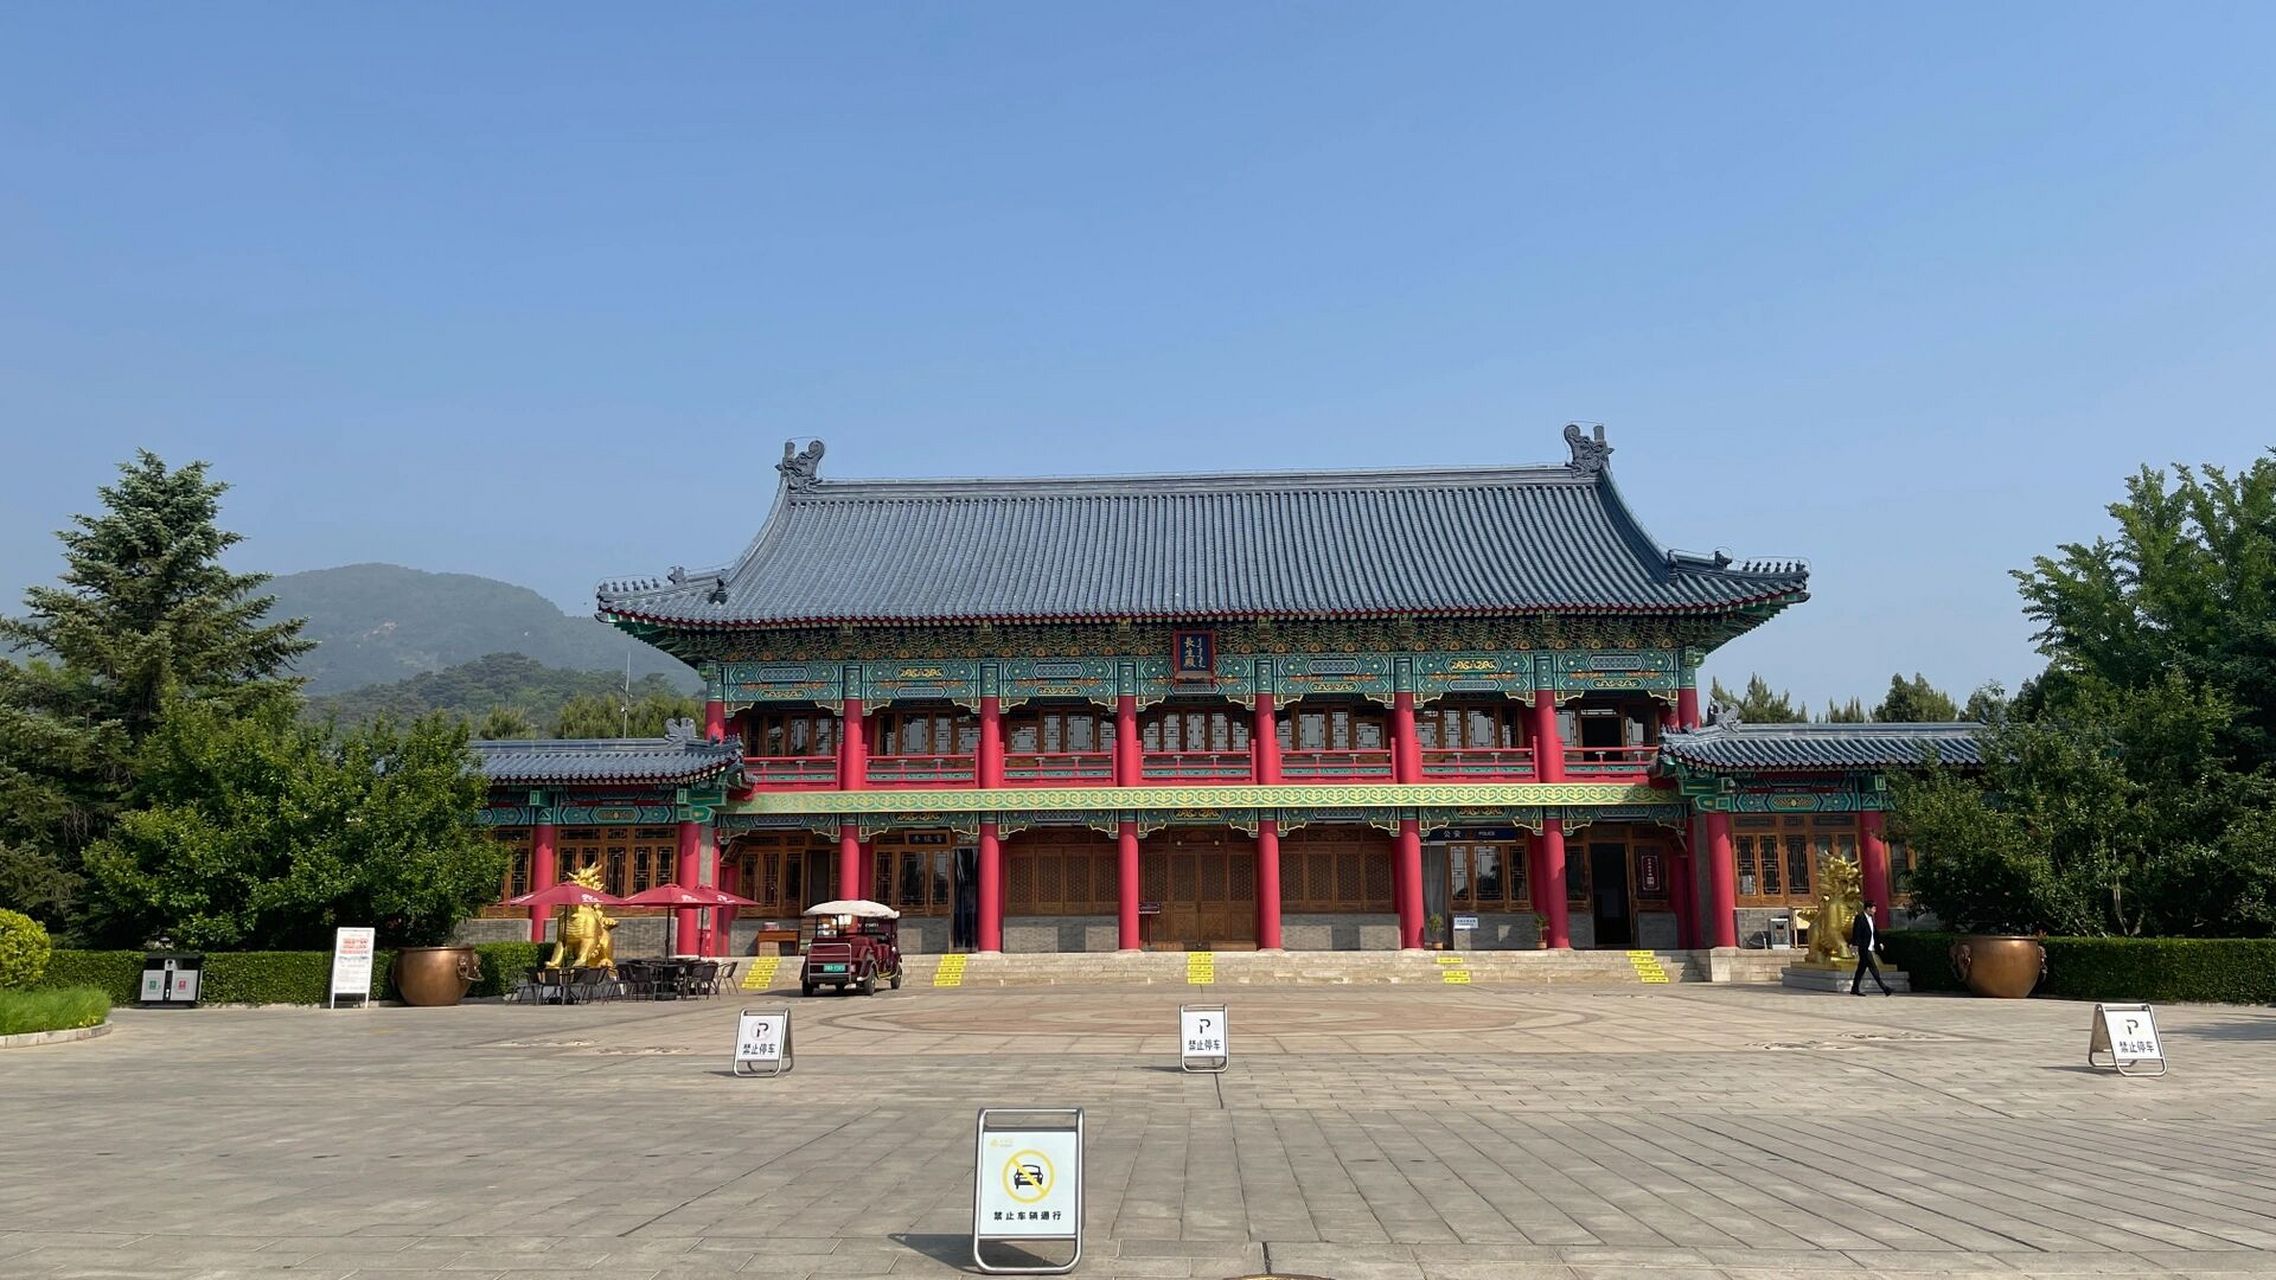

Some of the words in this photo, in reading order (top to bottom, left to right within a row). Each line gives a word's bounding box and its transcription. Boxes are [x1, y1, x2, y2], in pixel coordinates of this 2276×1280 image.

[1443, 830, 1462, 838] 公安
[742, 1043, 776, 1055] 禁止停车
[1189, 1039, 1221, 1051] 禁止停车
[2119, 1041, 2154, 1053] 禁止停车
[994, 1211, 1062, 1221] 禁止车辆通行
